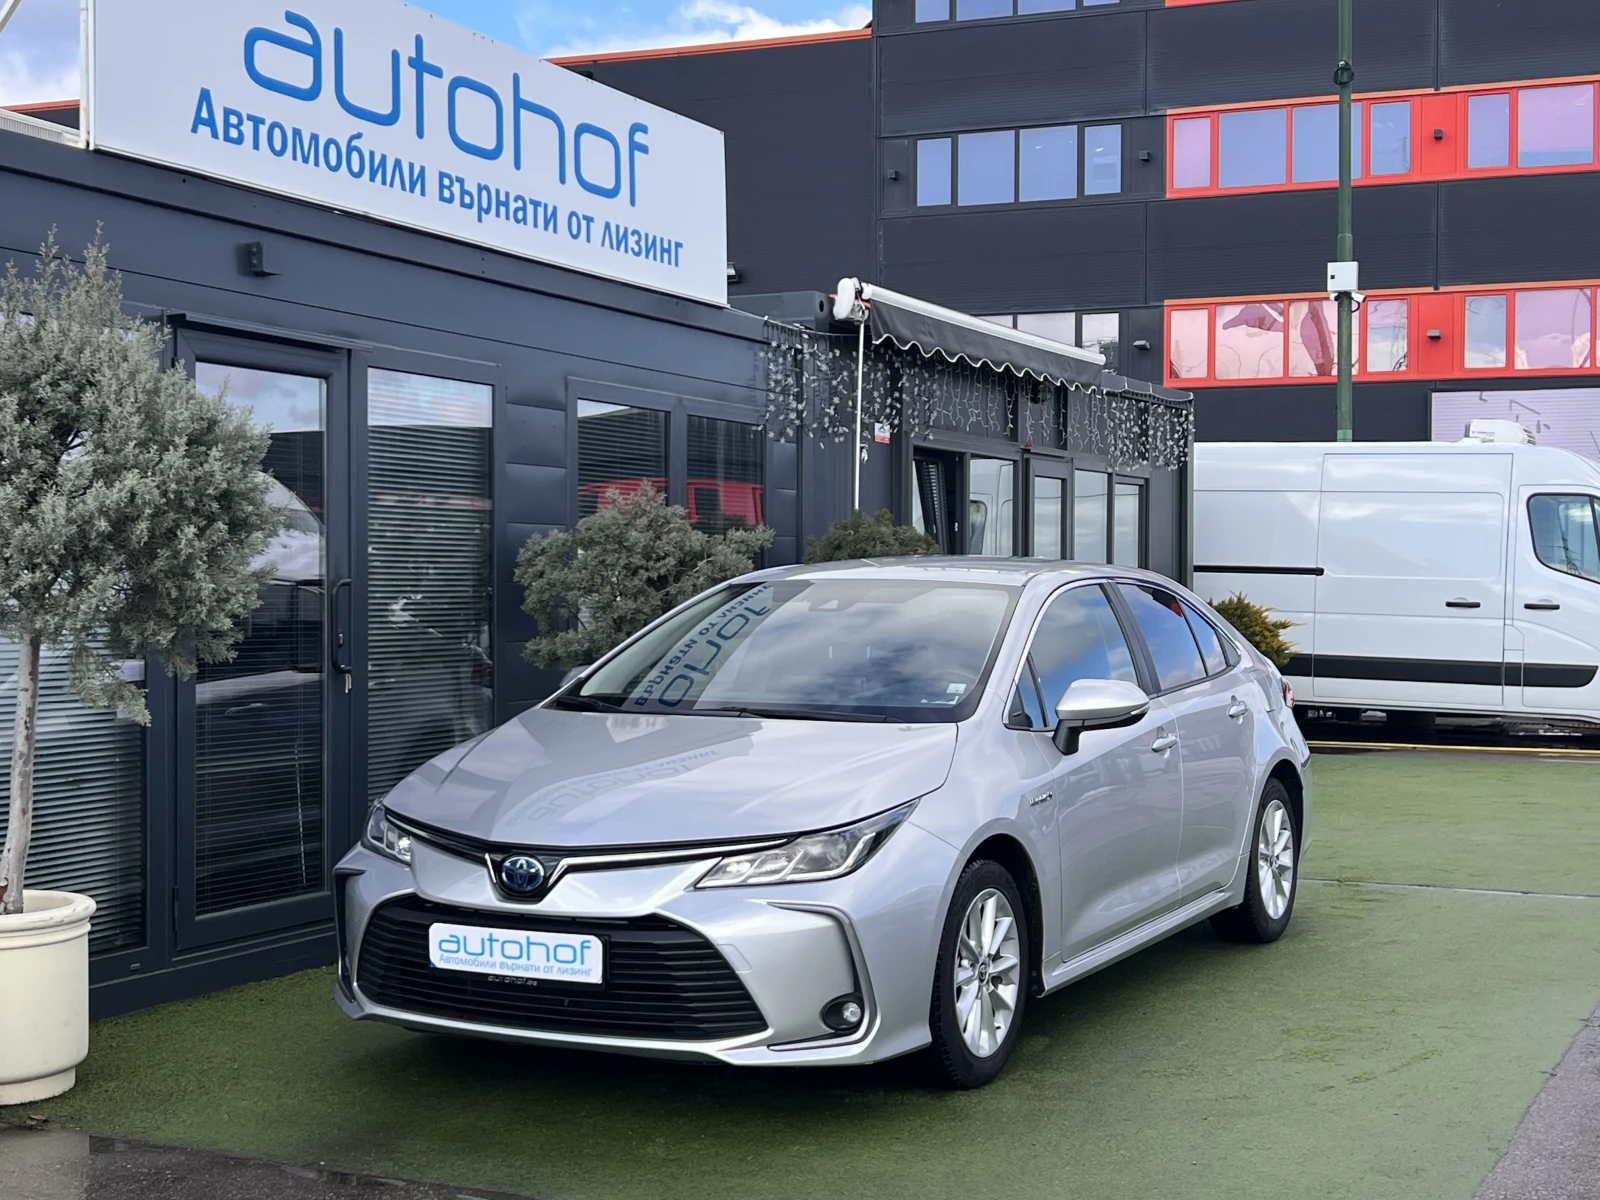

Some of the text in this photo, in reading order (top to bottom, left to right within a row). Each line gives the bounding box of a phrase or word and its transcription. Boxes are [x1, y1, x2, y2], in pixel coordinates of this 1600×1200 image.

[242, 10, 650, 208] autohof
[190, 86, 684, 268] Автомобили върнати от лизинг
[438, 932, 592, 965] autohof
[438, 953, 593, 977] Автомобили върнати от лизинг
